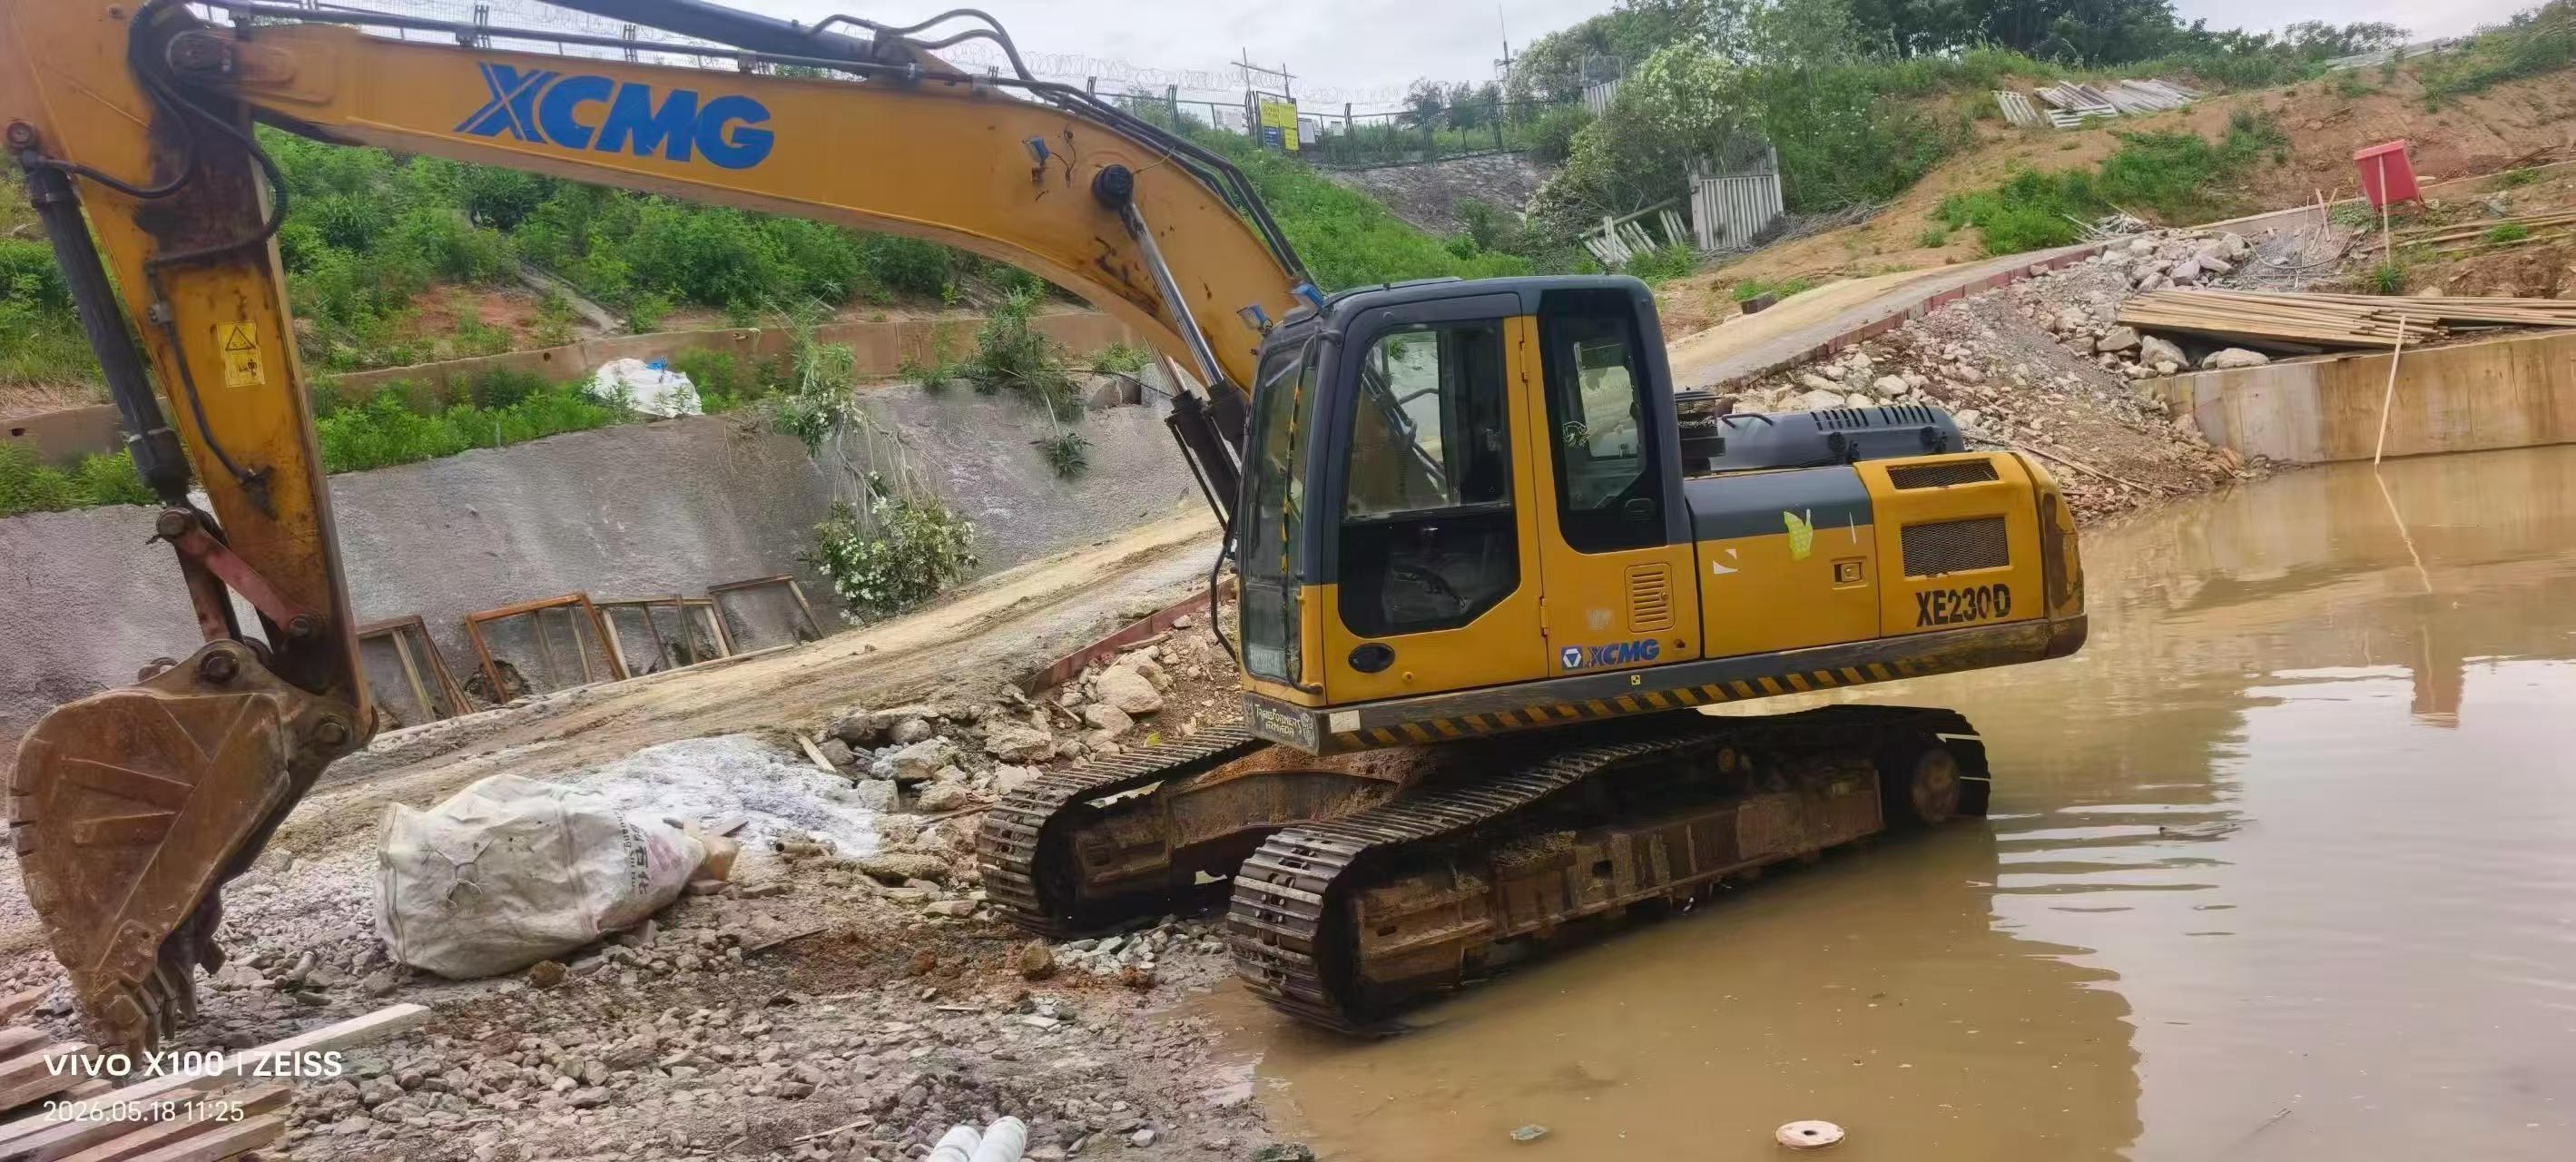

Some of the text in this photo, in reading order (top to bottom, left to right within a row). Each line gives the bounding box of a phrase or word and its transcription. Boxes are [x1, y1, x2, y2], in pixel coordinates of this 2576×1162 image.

[454, 61, 774, 170] XCMG
[1915, 584, 2011, 627] XE230D
[1583, 639, 1660, 668] XCMG
